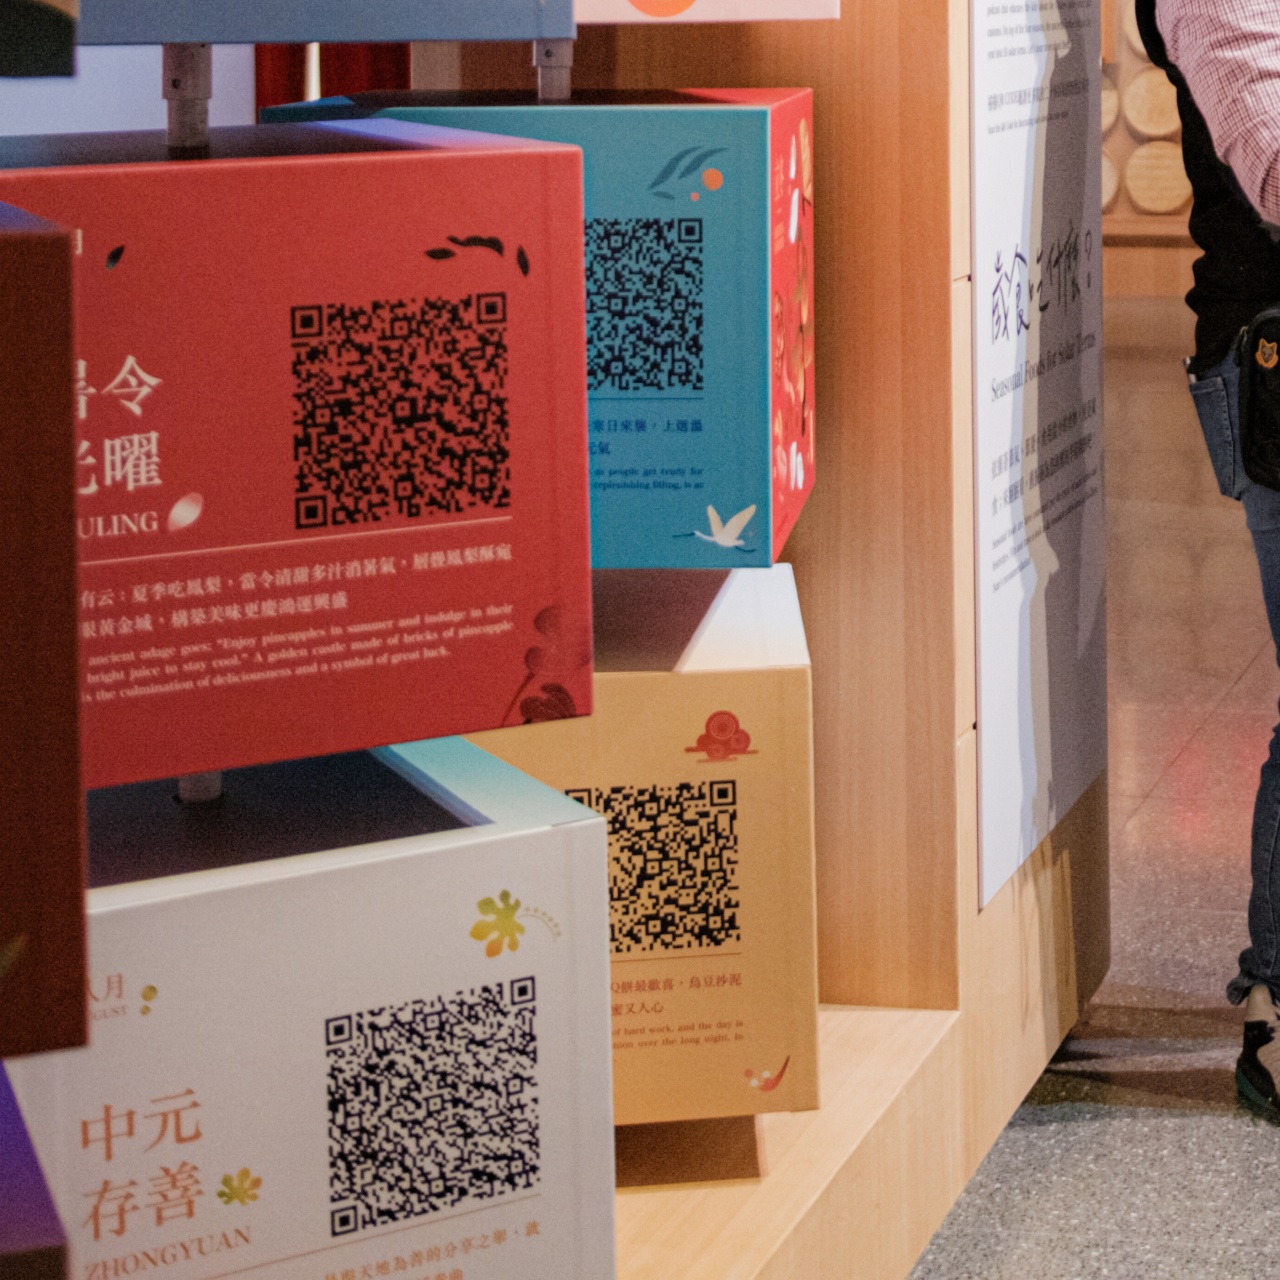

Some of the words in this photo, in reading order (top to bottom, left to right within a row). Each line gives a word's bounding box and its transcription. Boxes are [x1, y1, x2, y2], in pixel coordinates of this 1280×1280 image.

[991, 370, 1024, 402] Seasonal
[77, 511, 159, 539] ULING
[397, 615, 420, 627] and
[677, 1023, 695, 1032] and
[697, 1022, 712, 1030] the
[735, 1019, 743, 1027] is
[80, 1088, 203, 1162] 中元
[82, 1161, 205, 1241] 存善
[84, 1225, 252, 1280] ZHONGYUAN
